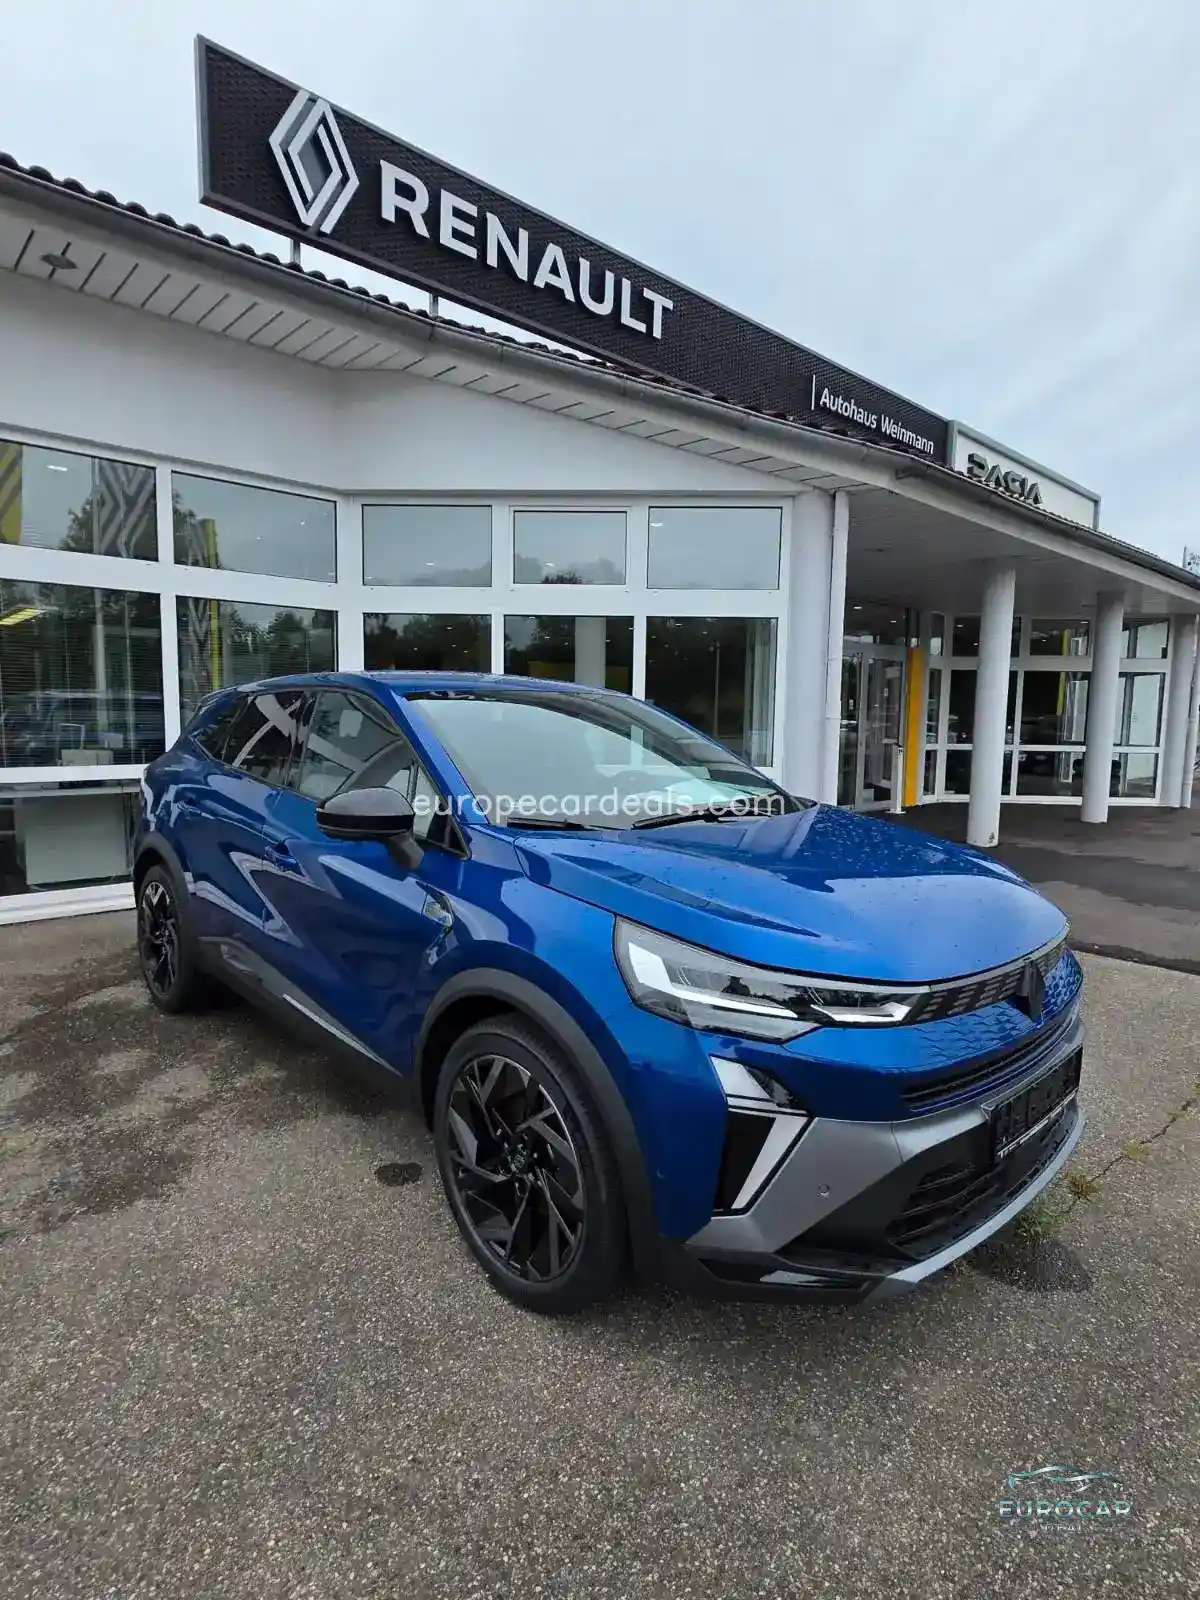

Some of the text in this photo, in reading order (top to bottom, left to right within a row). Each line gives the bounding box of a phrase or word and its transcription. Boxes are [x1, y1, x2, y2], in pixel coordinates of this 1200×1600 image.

[379, 159, 674, 340] RENAULT
[820, 387, 934, 455] Autohaus Weinmann
[967, 452, 1043, 505] DACIA
